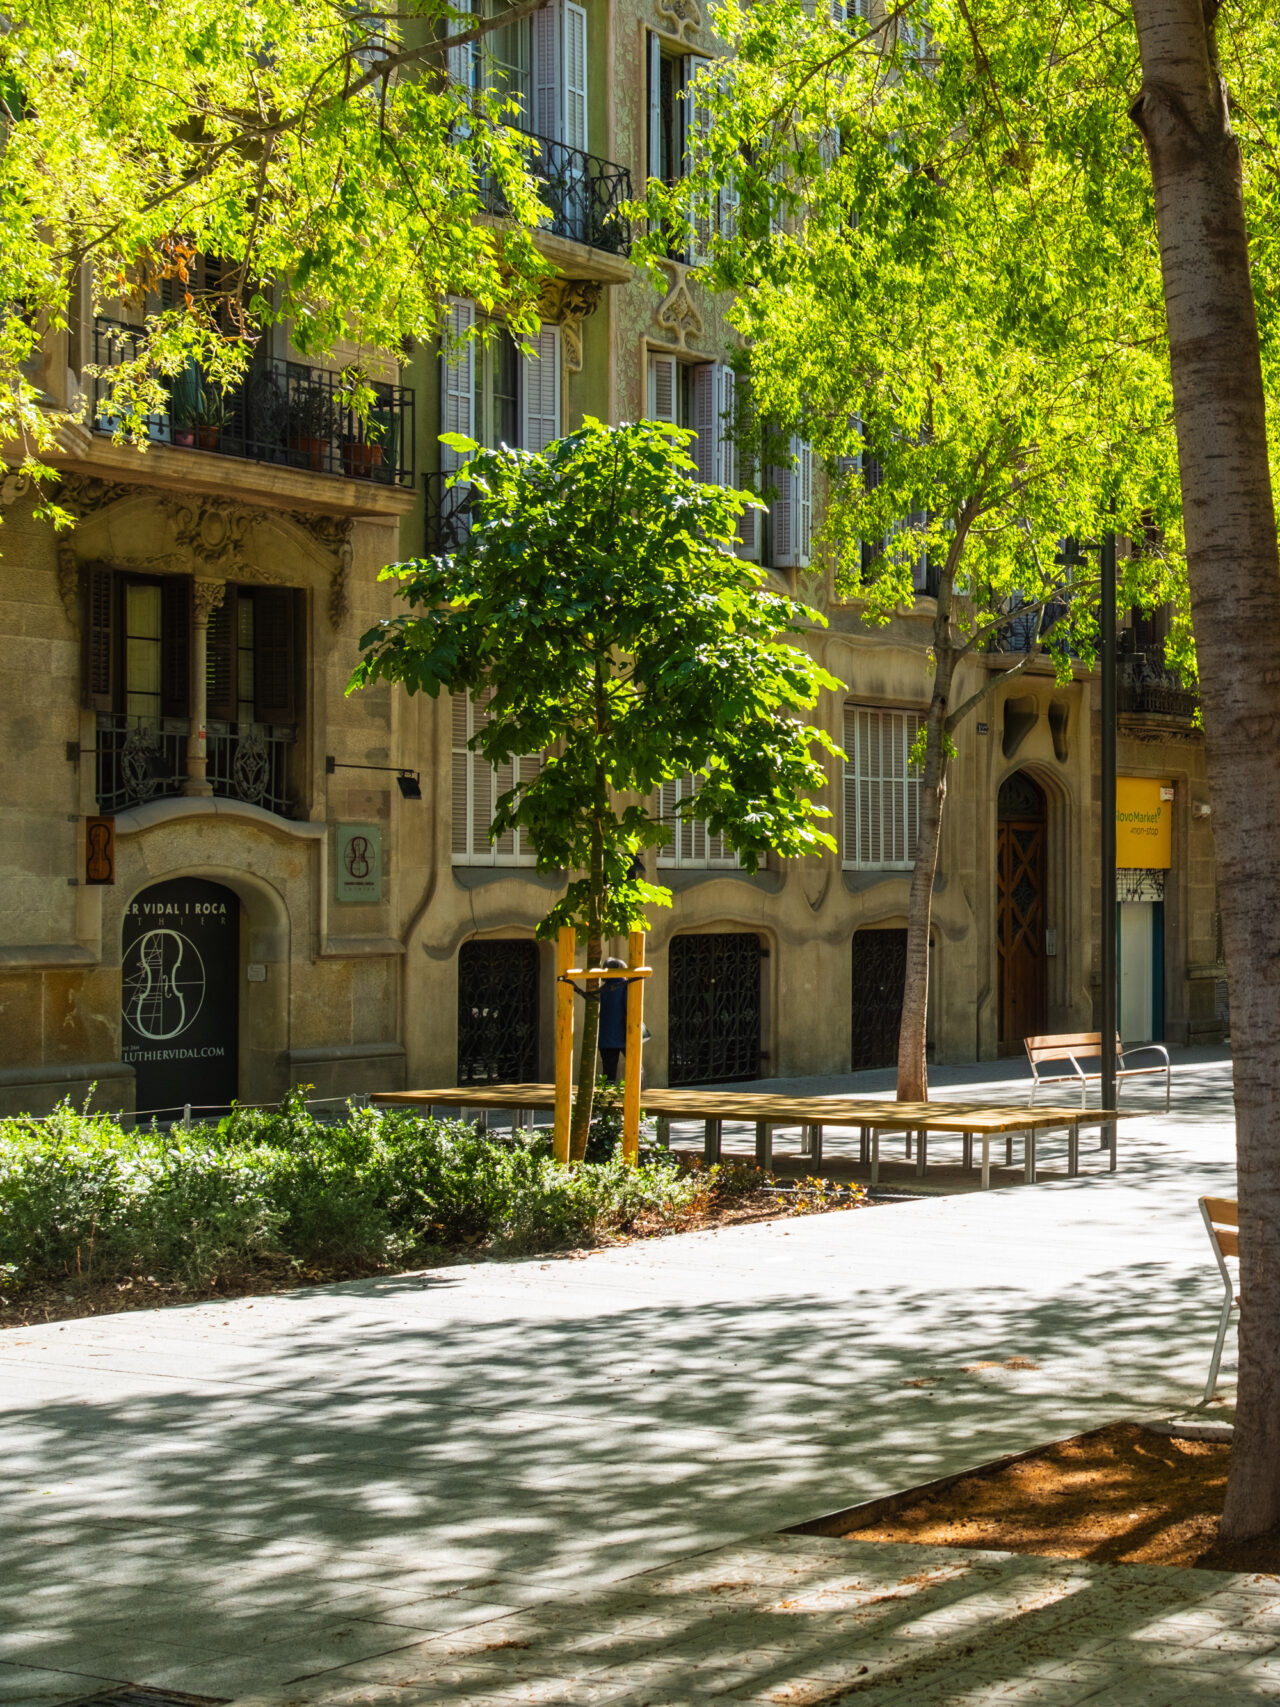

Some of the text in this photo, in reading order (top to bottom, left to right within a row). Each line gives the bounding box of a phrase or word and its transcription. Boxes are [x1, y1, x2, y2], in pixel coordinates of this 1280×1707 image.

[144, 903, 180, 914] VIDAL
[186, 904, 189, 914] I
[195, 903, 226, 914] ROCA
